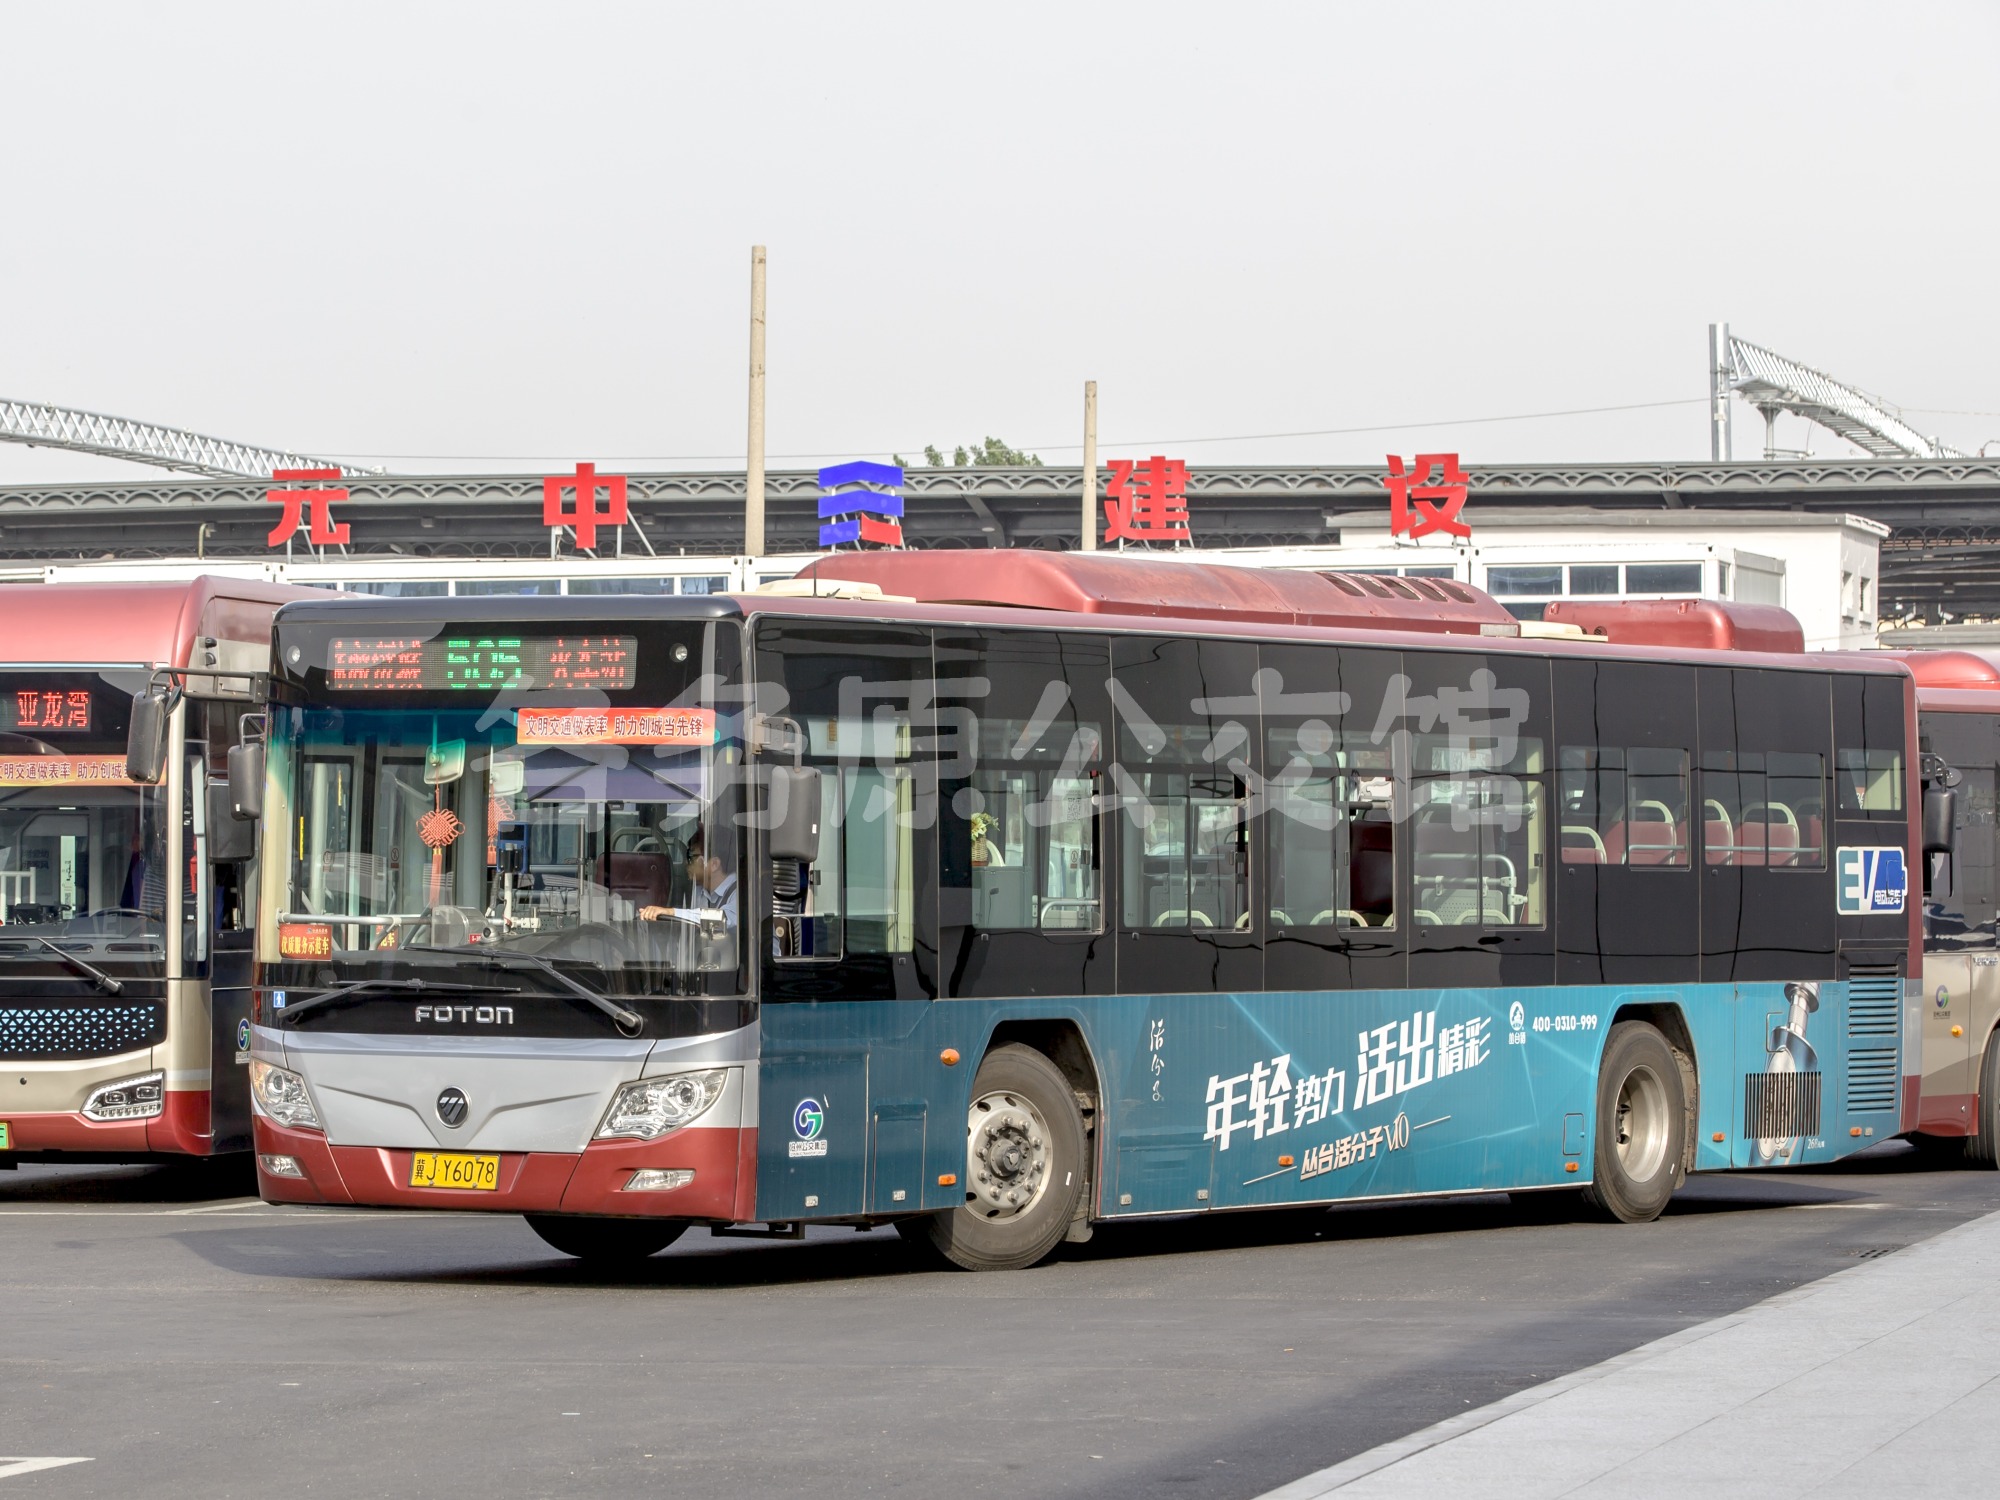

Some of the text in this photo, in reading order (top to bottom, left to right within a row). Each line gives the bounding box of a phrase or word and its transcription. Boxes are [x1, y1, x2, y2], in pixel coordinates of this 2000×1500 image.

[17, 691, 89, 727] 亚龙湾
[525, 715, 704, 737] 文明交通做表率 助力创城当先锋
[0, 762, 72, 780] 明交通做表率
[281, 935, 330, 956] 优质服务示范车
[415, 1005, 514, 1025] FOTON
[1532, 1014, 1598, 1032] 400-0310-999
[1203, 1010, 1492, 1152] 年轻势力 活出精彩
